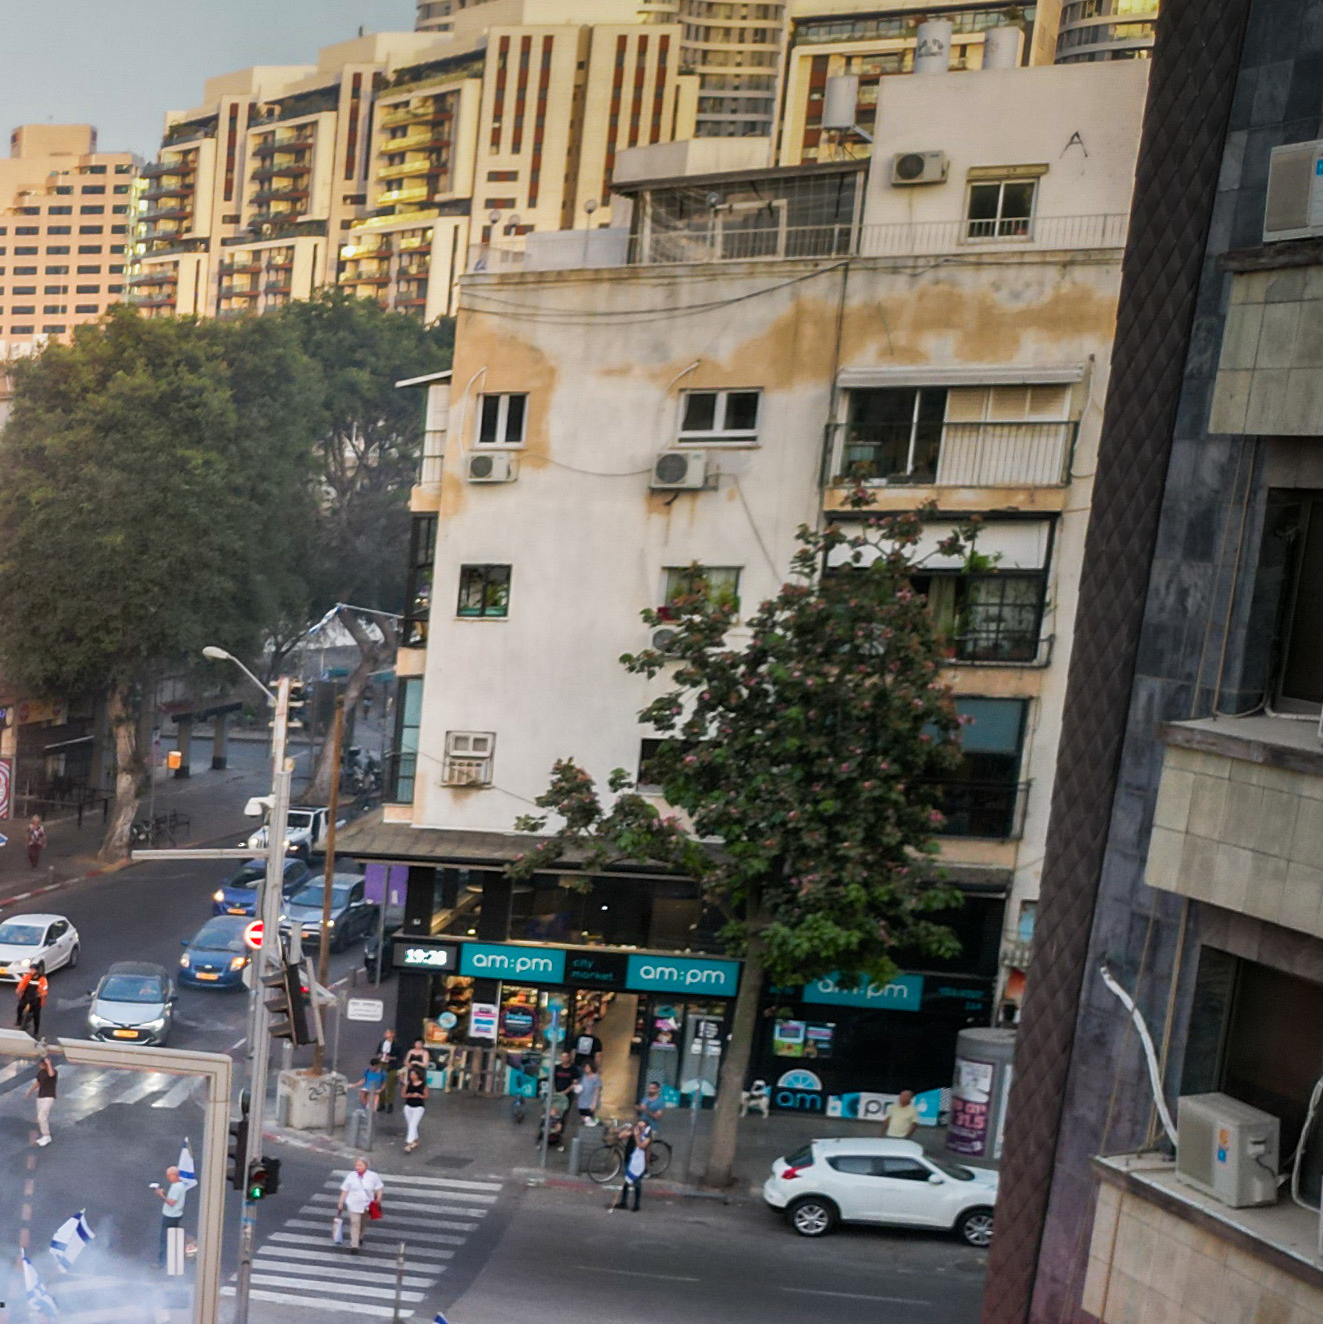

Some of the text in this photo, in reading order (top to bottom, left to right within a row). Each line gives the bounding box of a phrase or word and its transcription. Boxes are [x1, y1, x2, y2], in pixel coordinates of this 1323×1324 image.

[472, 953, 553, 973] am:pm
[571, 958, 594, 969] city
[571, 969, 614, 982] market
[639, 965, 725, 986] am:pm
[776, 1091, 823, 1111] am
